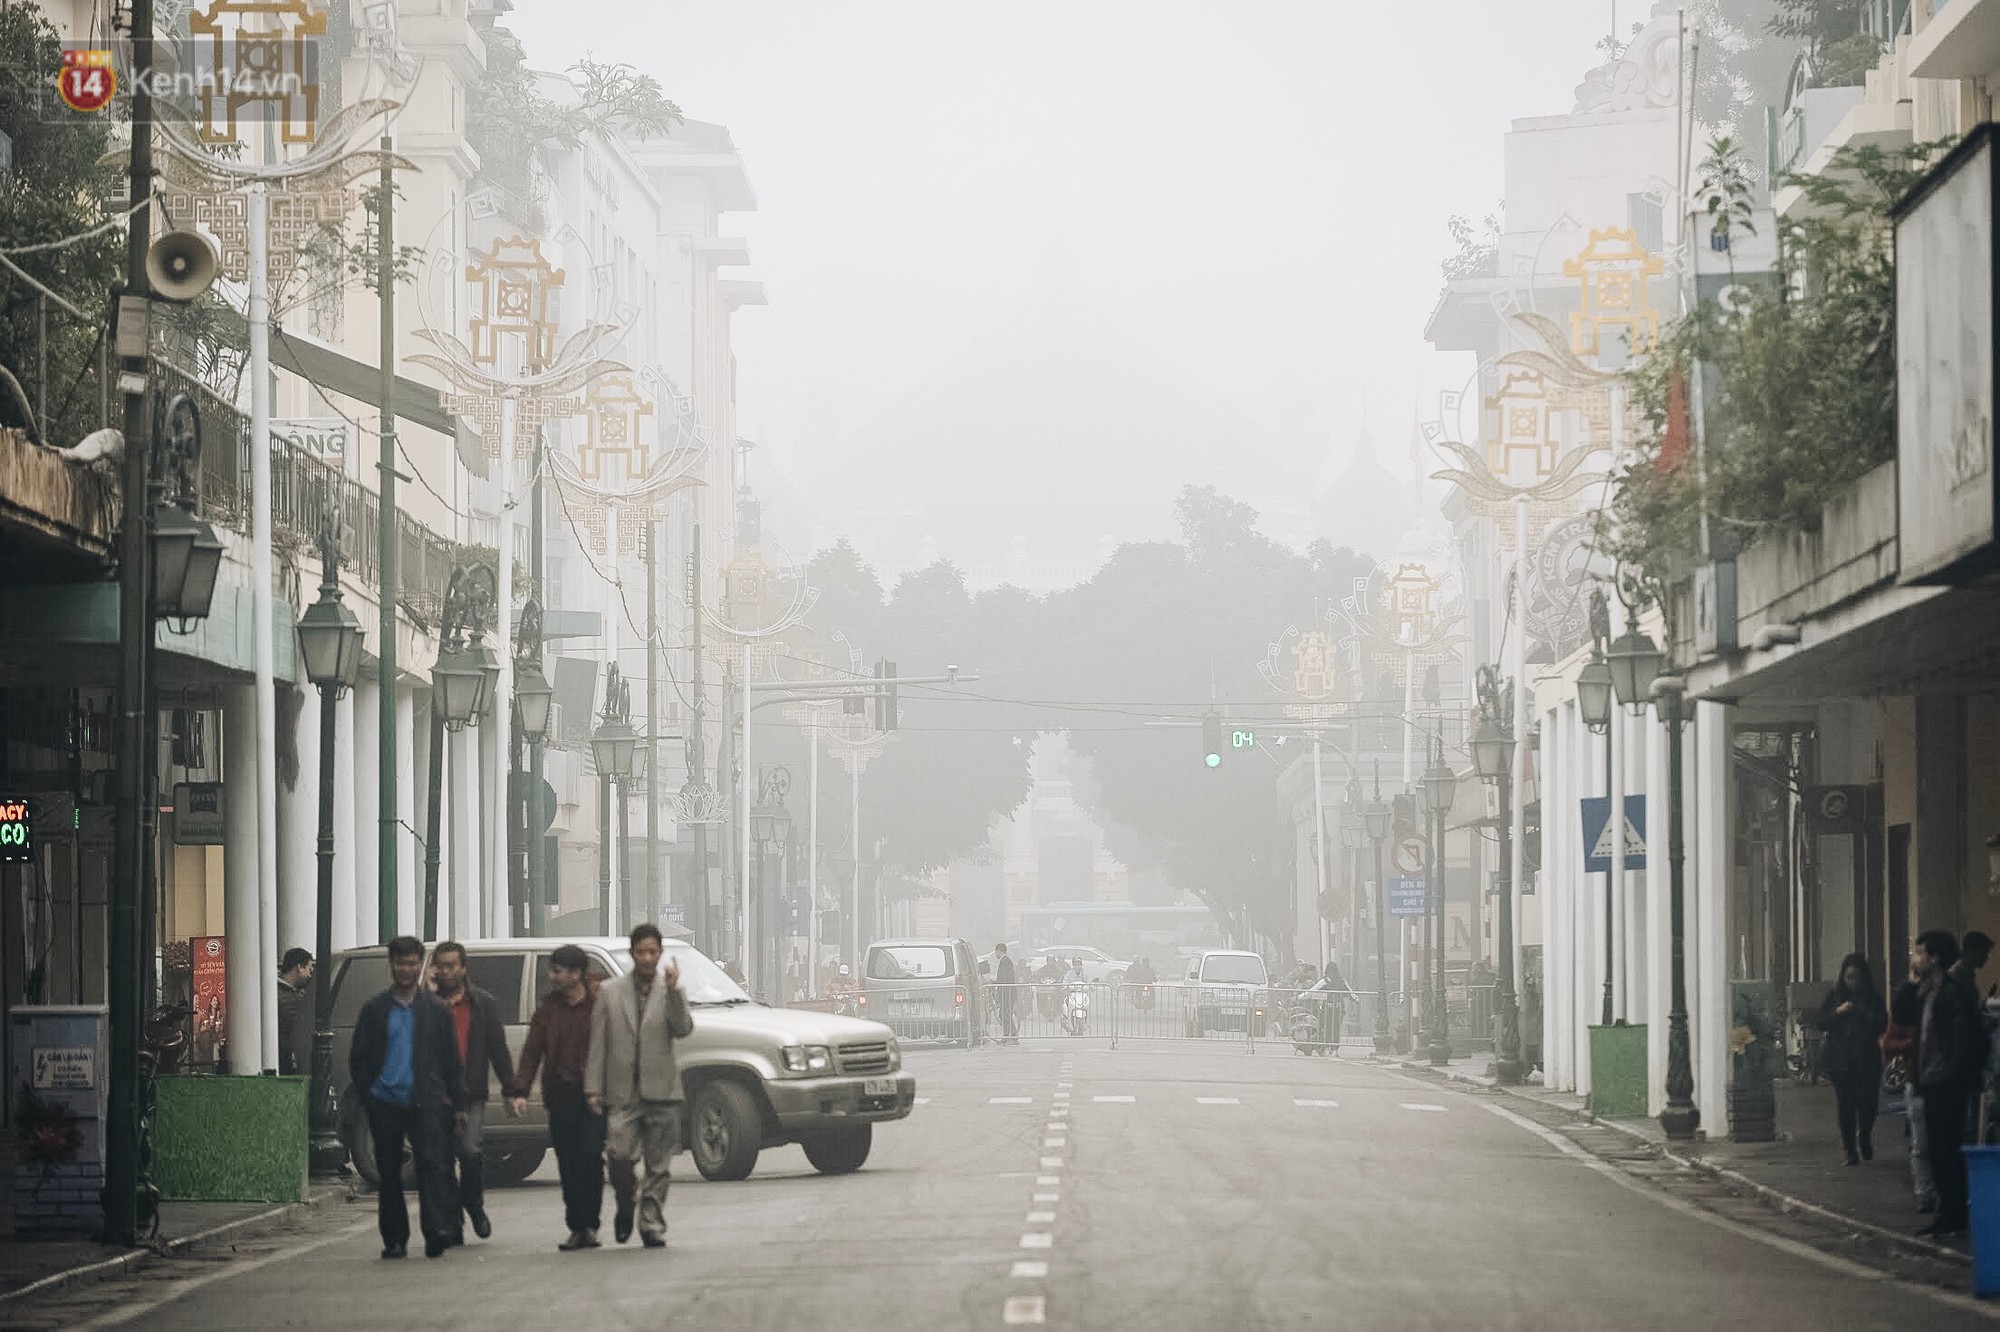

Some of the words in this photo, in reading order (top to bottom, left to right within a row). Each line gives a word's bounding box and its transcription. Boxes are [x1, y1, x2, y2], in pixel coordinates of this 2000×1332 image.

[1543, 540, 1560, 580] KEM
[1232, 731, 1253, 748] 04
[0, 805, 25, 821] ACY
